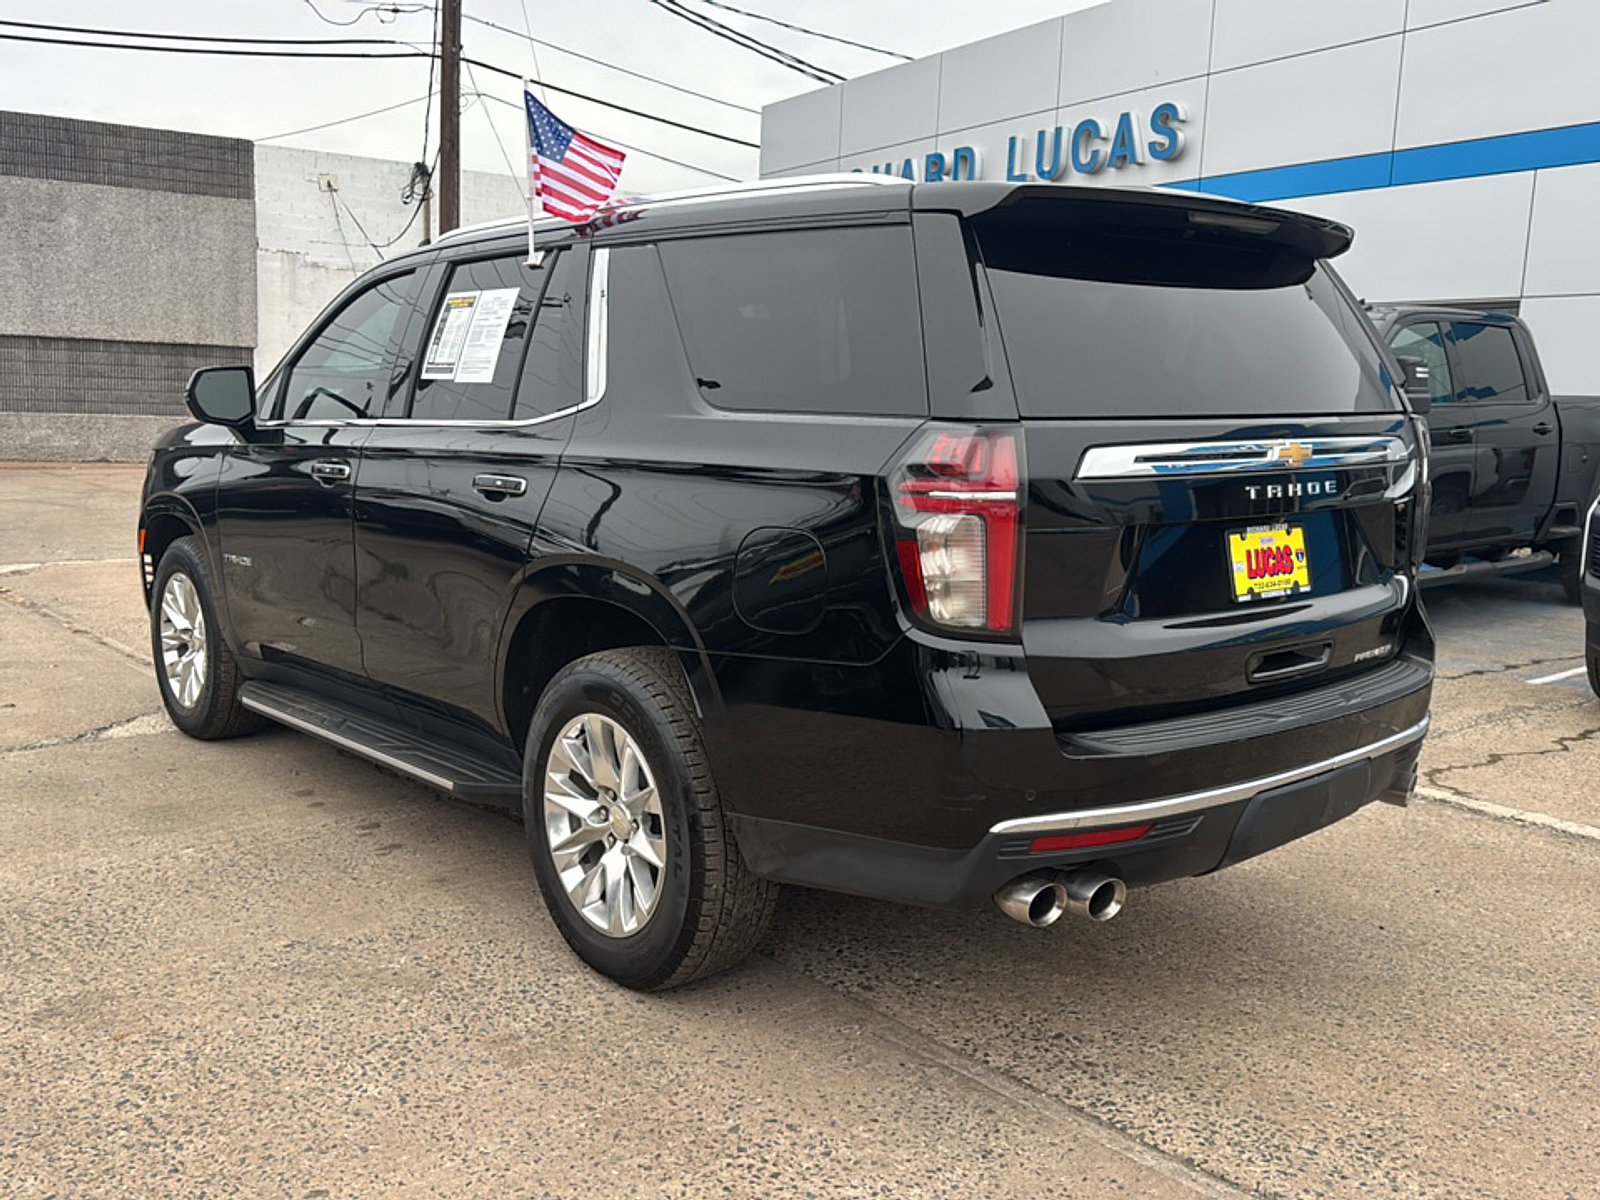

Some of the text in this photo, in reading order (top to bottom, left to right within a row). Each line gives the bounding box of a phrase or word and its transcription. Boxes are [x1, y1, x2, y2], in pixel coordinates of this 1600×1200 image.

[1006, 102, 1184, 183] LUCAS
[1245, 480, 1338, 500] TAHOE
[1246, 545, 1294, 579] LUCAS
